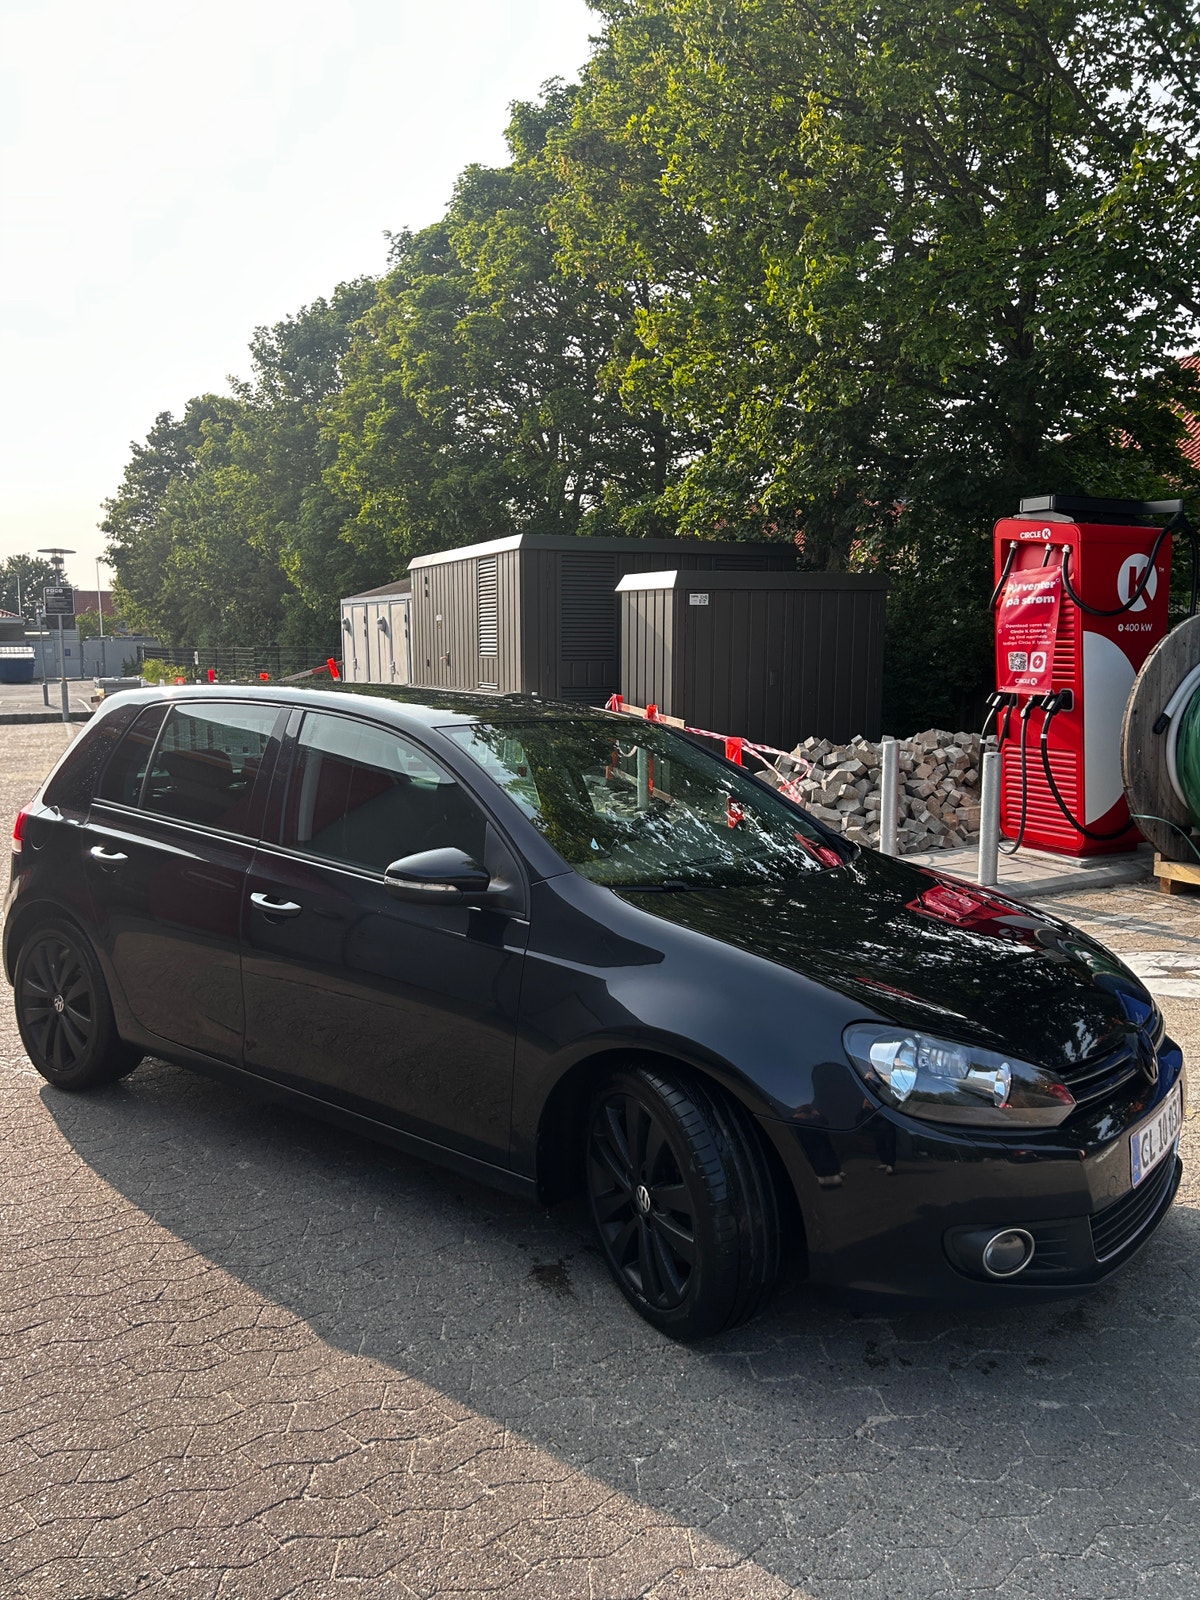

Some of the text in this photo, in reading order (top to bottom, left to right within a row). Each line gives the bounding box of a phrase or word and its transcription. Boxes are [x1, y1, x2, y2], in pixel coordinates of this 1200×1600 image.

[1020, 528, 1051, 539] CIRCLE K
[1022, 581, 1055, 591] venter
[1006, 595, 1055, 608] på strøm
[1141, 623, 1153, 631] kW
[1141, 1129, 1155, 1168] CL
[1158, 1112, 1168, 1153] 10
